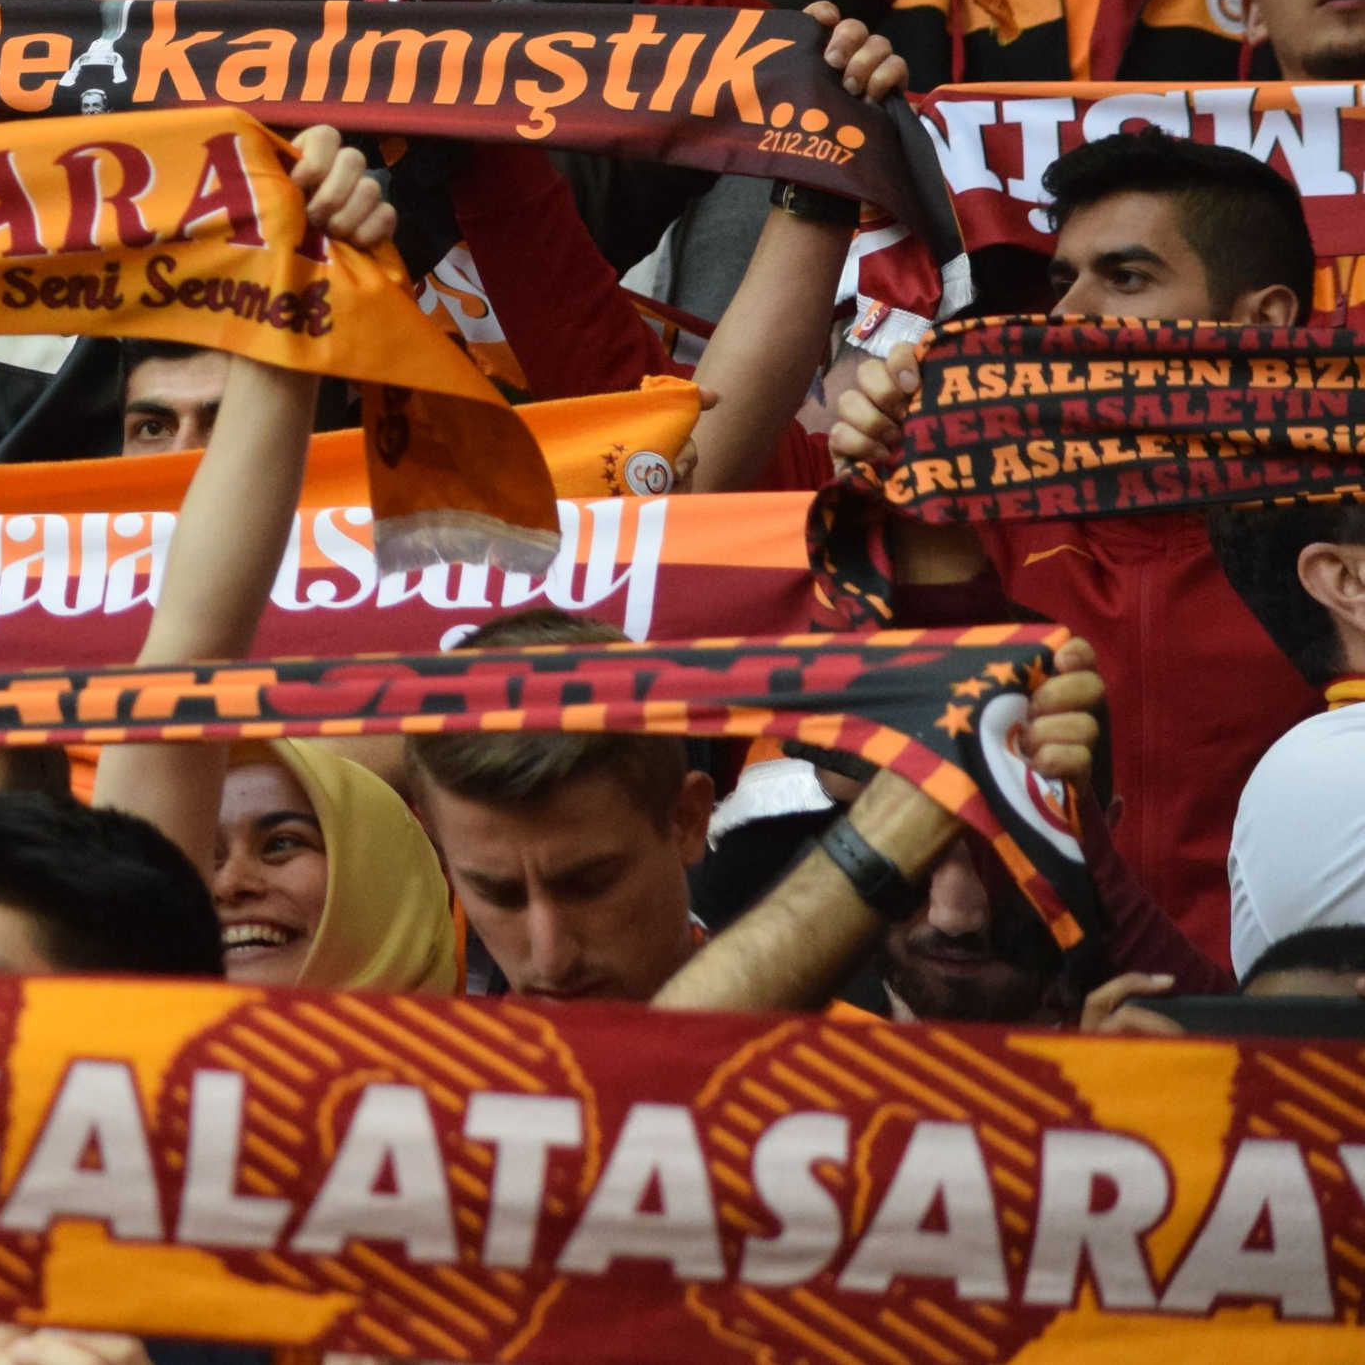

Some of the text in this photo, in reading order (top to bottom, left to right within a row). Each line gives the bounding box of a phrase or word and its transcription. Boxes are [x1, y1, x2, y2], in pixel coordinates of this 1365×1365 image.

[757, 128, 856, 166] 21.12.2017
[1, 261, 124, 312] Seni
[139, 254, 335, 338] Sevmek
[936, 358, 1232, 407] ASALETİN
[1059, 389, 1350, 436] ASALETİN
